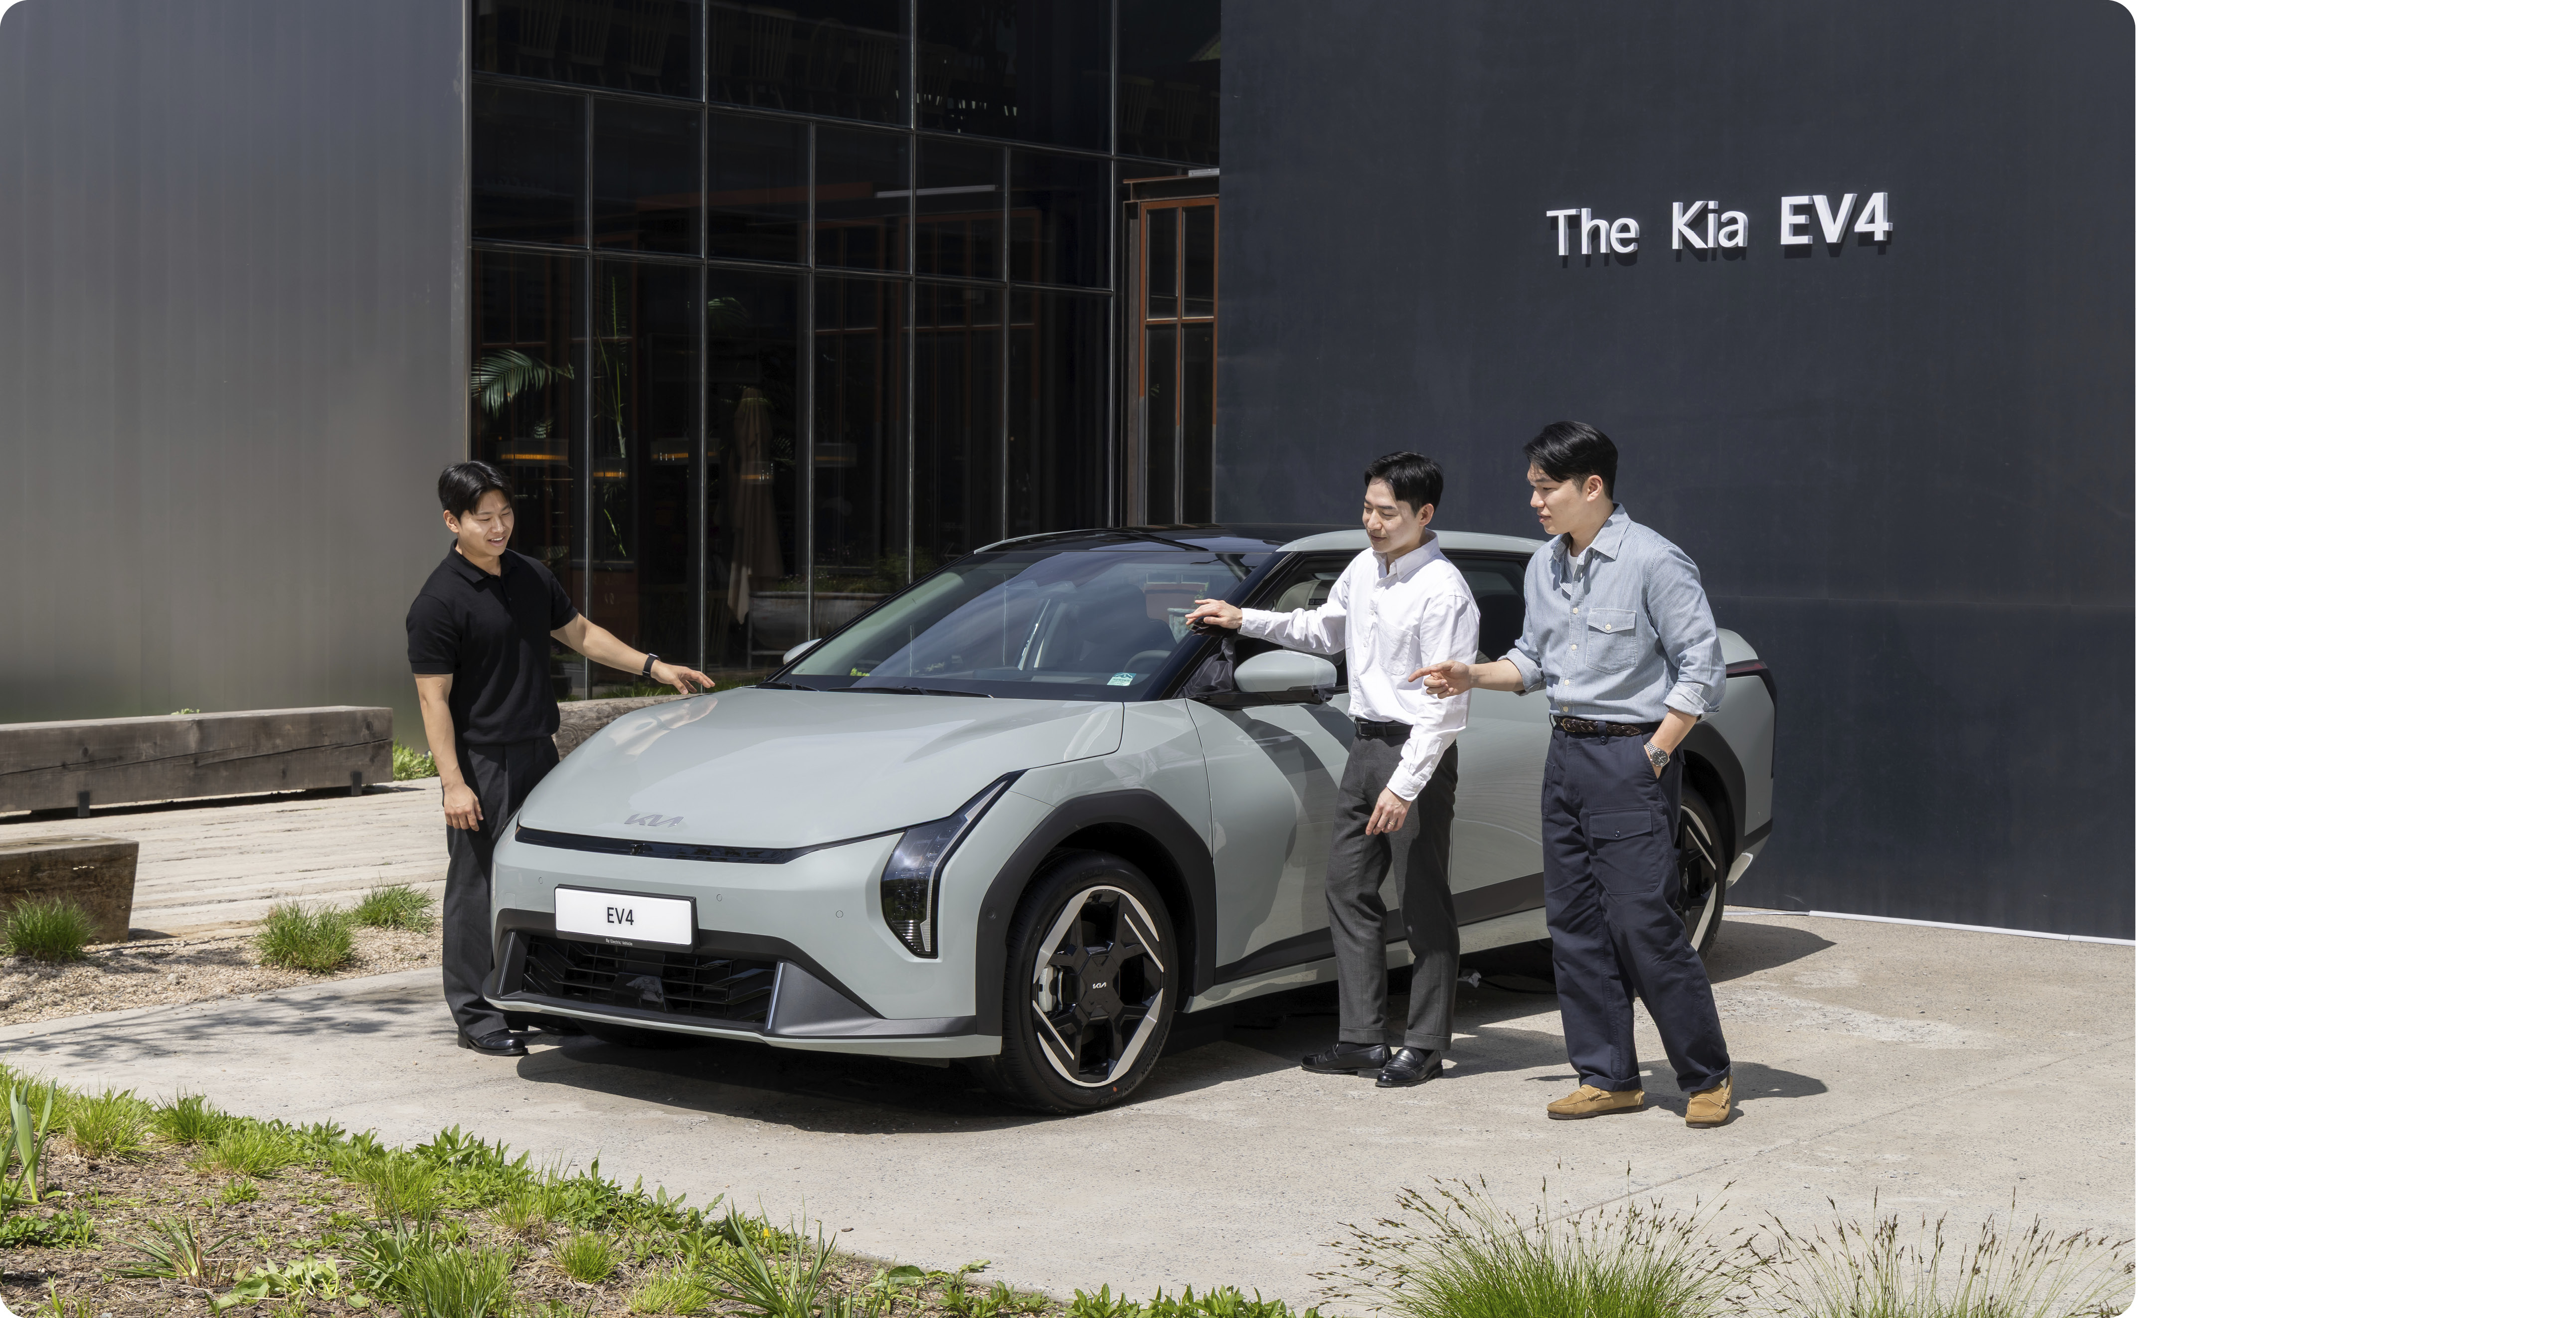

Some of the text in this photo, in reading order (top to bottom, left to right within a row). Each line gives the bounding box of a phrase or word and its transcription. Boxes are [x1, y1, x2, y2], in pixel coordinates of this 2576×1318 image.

[1546, 192, 1892, 255] The Kia EV4
[624, 814, 684, 827] KIA
[607, 907, 634, 925] EV4
